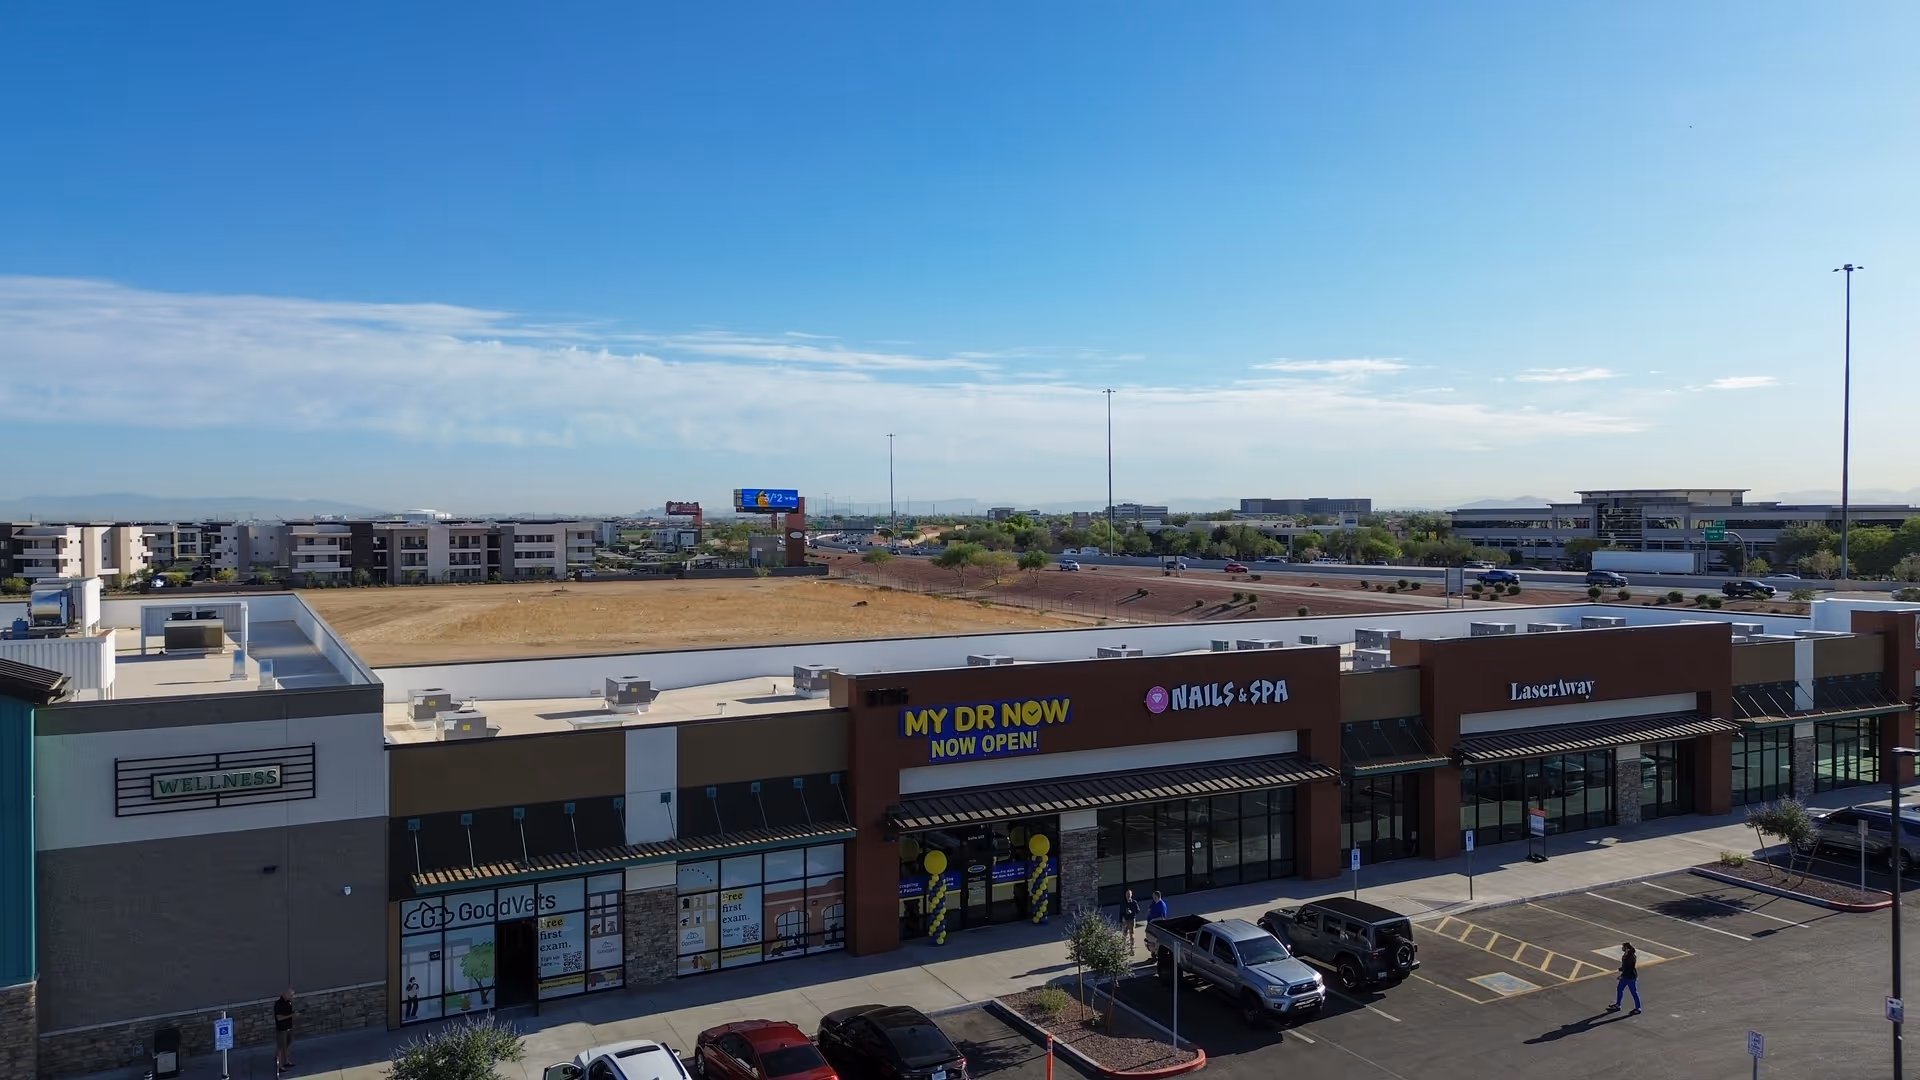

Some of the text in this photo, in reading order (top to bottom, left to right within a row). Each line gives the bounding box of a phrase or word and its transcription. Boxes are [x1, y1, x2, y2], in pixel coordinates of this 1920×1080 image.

[1172, 681, 1235, 711] NAILS
[1238, 687, 1247, 703] &
[1250, 679, 1289, 705] SPA
[1510, 679, 1595, 701] LaserAway
[905, 698, 1070, 736] MY DR NOW
[931, 731, 1038, 758] NOW OPEN!
[158, 770, 277, 794] WELLNESS
[722, 892, 743, 901] Free
[459, 893, 556, 921] GoodVets
[722, 903, 742, 912] first
[540, 918, 563, 929] Free
[722, 914, 750, 924] exam.
[540, 929, 562, 940] first
[540, 941, 571, 952] exam.
